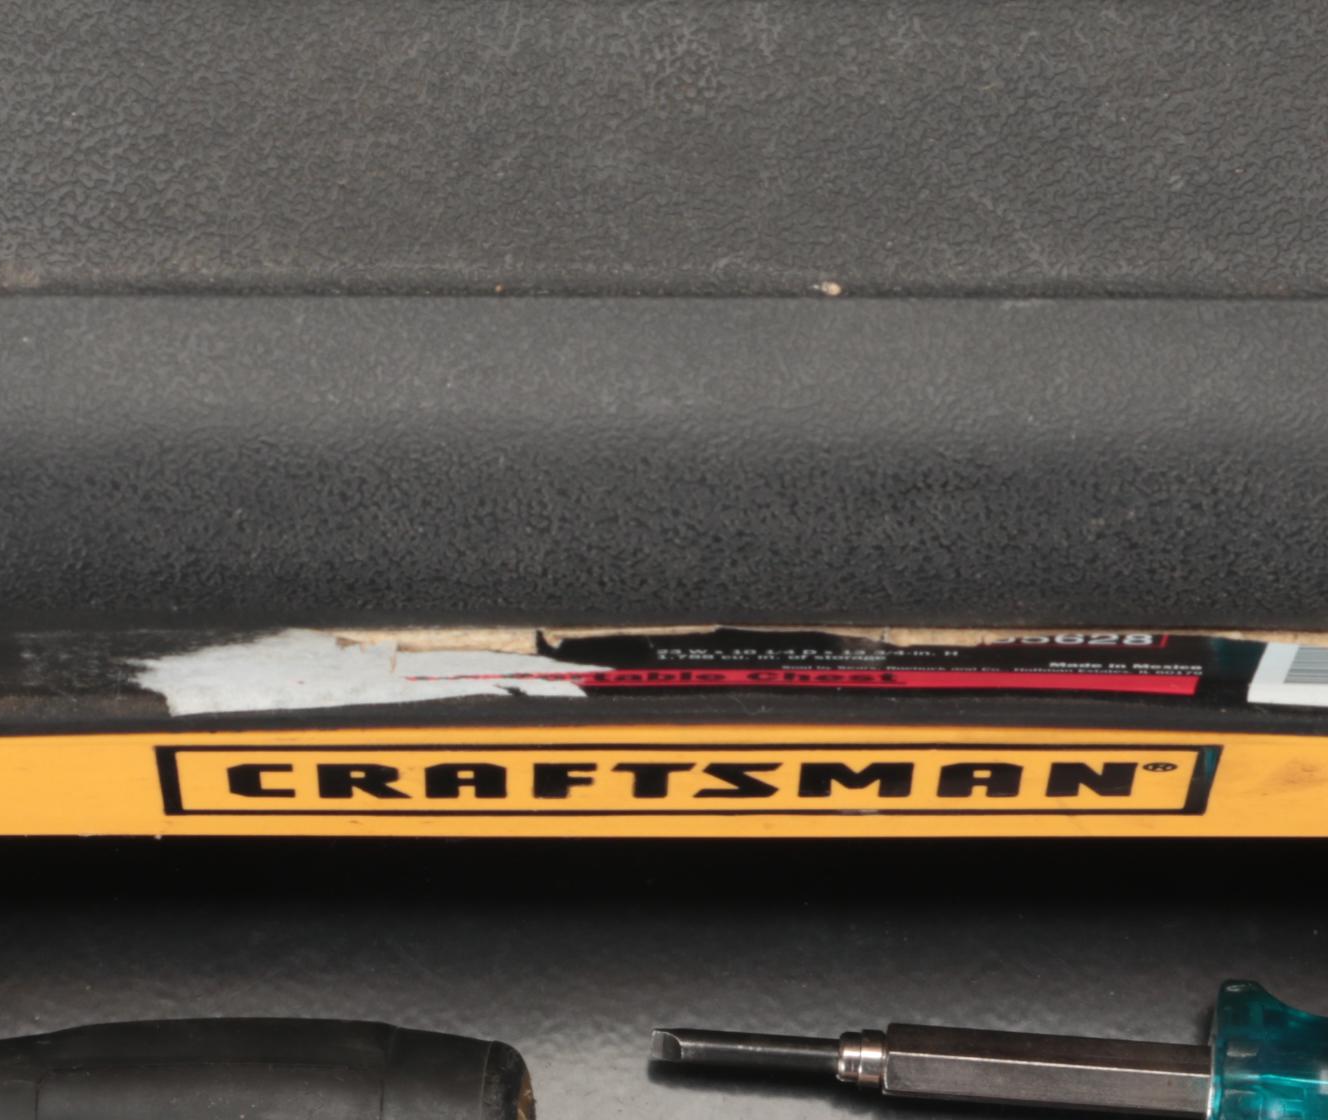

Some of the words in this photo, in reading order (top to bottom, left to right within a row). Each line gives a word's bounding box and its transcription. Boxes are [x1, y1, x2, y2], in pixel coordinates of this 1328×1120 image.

[1048, 661, 1103, 669] Made
[1132, 663, 1203, 671] Mexico
[747, 671, 900, 684] Chest
